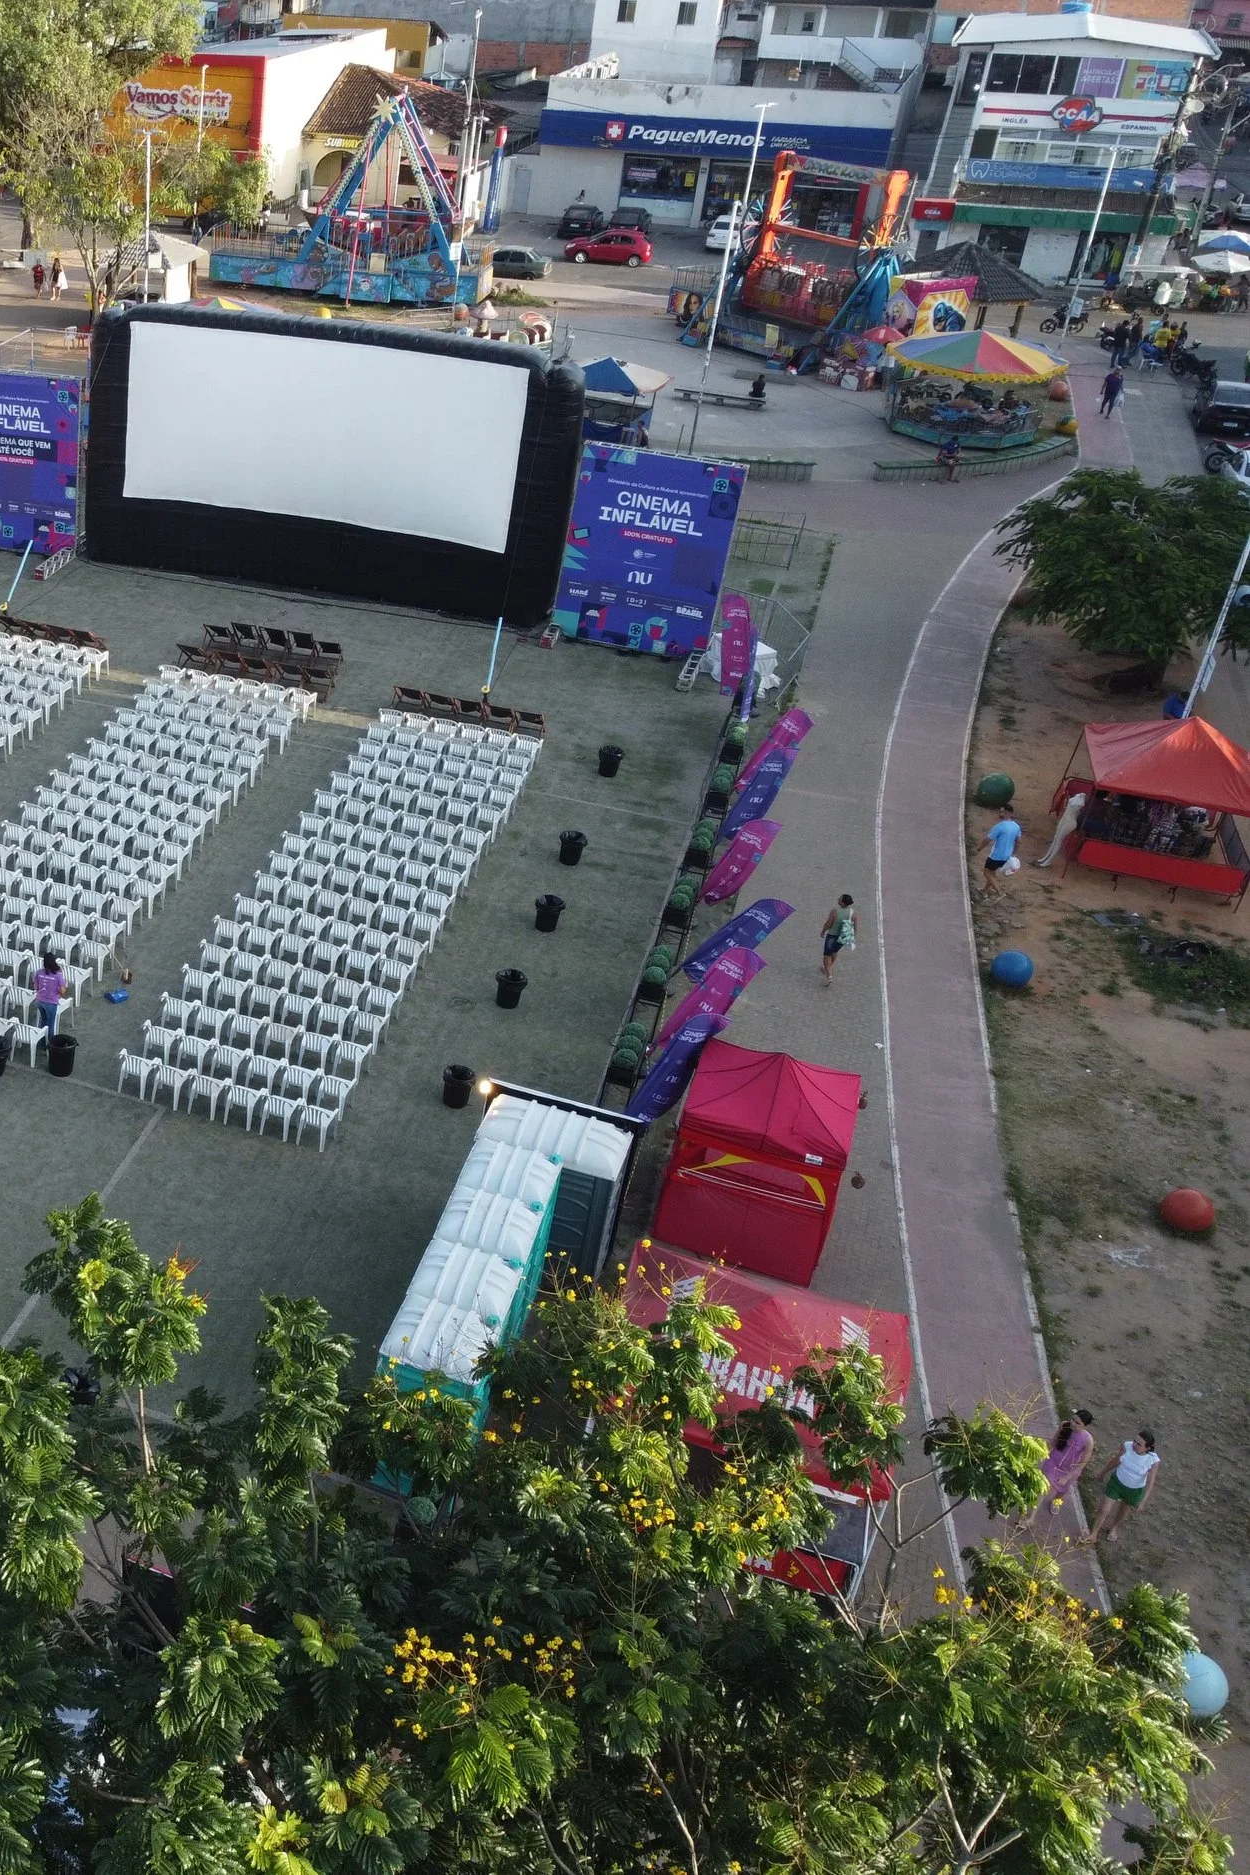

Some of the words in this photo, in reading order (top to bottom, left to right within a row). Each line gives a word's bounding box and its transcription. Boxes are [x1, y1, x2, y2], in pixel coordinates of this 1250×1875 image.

[127, 85, 178, 105] Vamos
[180, 87, 229, 107] Sorrir
[1053, 106, 1100, 123] CCAA
[628, 125, 766, 147] PagueMenos
[1121, 124, 1158, 132] ESPANHOL
[324, 137, 360, 149] SUBWAY
[17, 438, 35, 448] QUE
[34, 440, 51, 450] VEM
[617, 491, 692, 517] CINEMA
[598, 505, 703, 537] INFLÁVEL
[623, 530, 641, 539] 100%
[640, 533, 674, 544] GRATUITO
